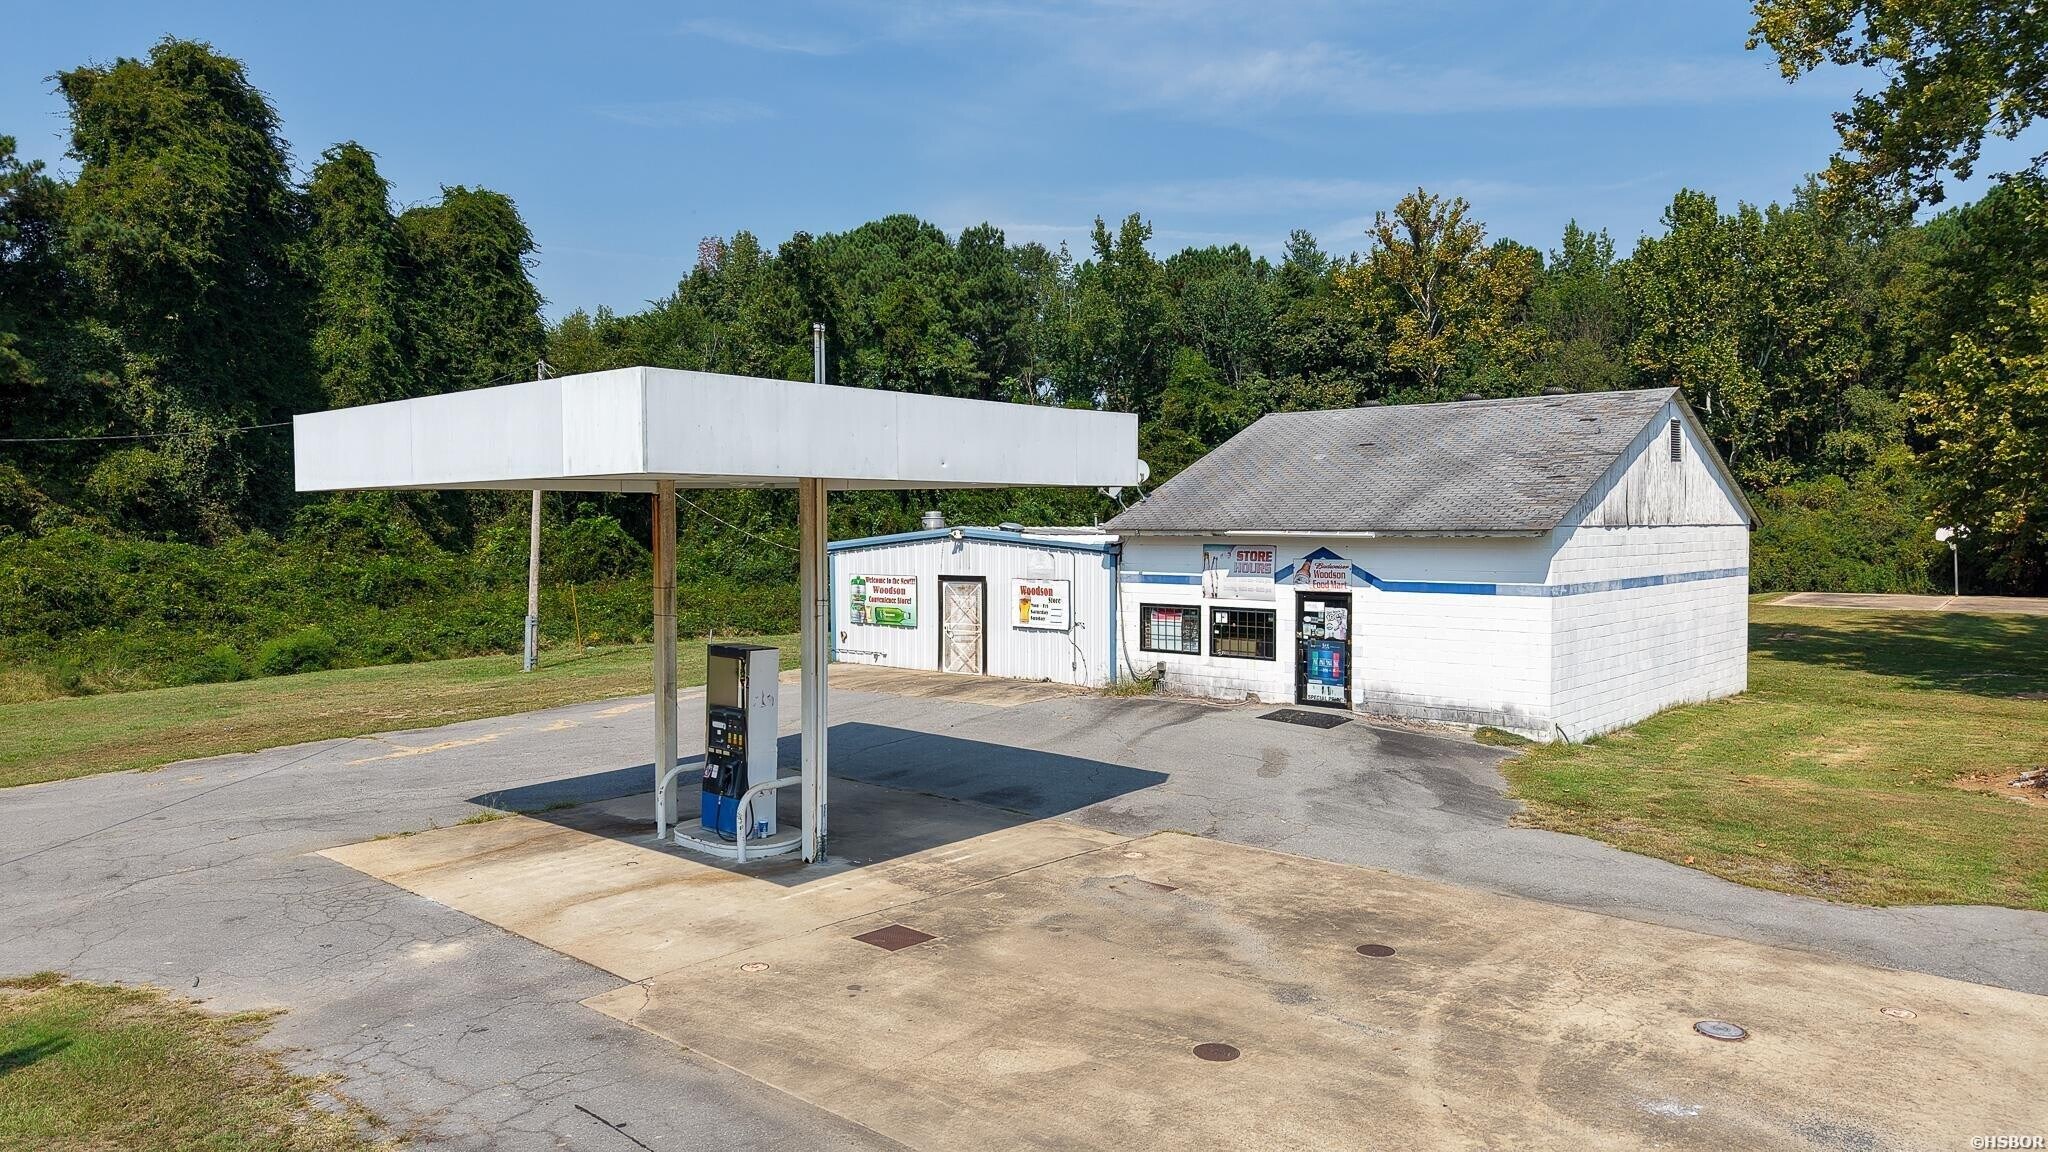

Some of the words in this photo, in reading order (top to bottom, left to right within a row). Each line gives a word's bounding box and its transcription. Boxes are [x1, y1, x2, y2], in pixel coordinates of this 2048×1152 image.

[1236, 550, 1273, 562] STORE
[1233, 562, 1272, 574] HOURS
[1315, 562, 1349, 570] Budweiser
[1313, 570, 1346, 579] Woodson
[865, 576, 886, 584] Welcome
[1312, 580, 1329, 589] Food
[1331, 580, 1347, 590] Mart
[872, 585, 906, 595] Woodson
[1020, 585, 1054, 597] Woodson
[868, 595, 897, 604] Convenience
